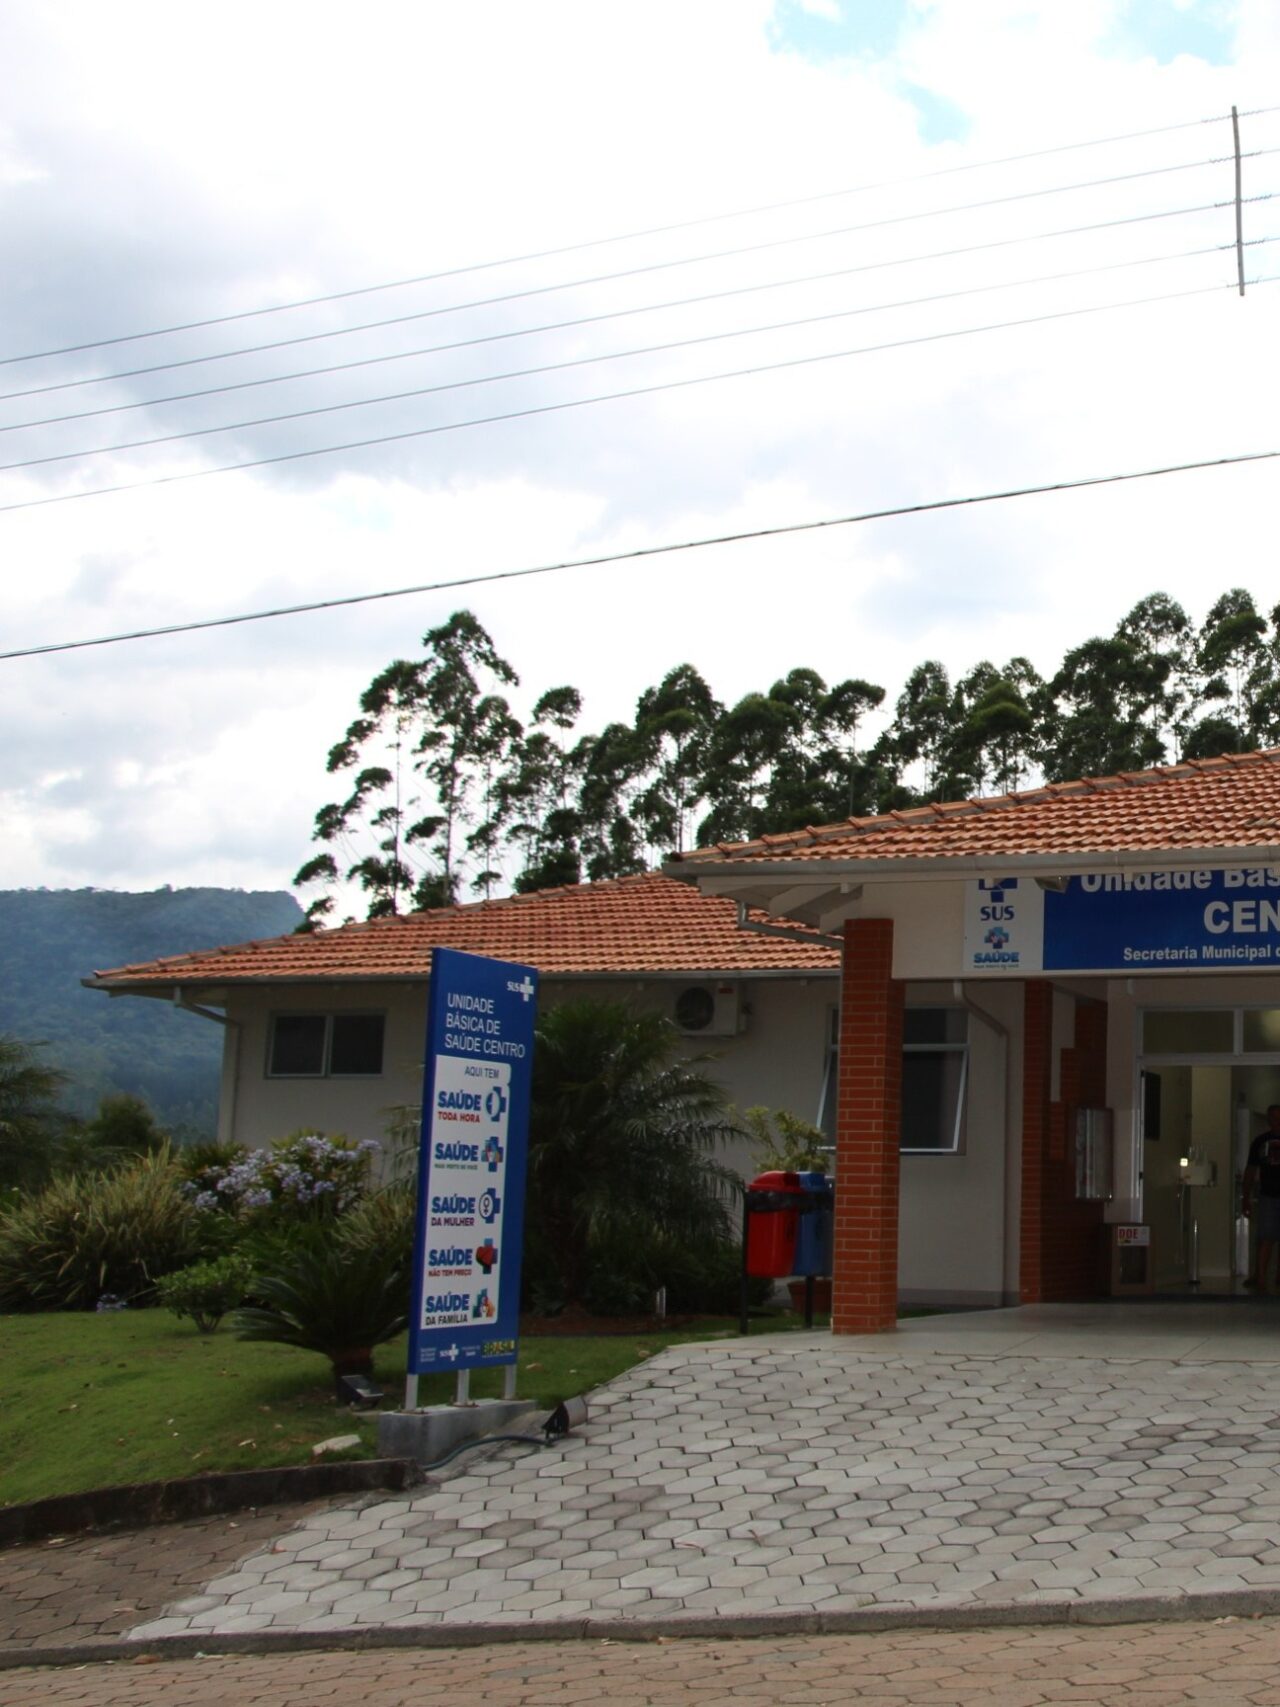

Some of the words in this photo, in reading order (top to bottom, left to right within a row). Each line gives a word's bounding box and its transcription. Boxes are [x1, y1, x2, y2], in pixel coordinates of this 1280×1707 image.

[980, 905, 1015, 921] SUS
[973, 951, 1019, 963] SAÚDE
[1123, 946, 1198, 962] Secretaria
[1202, 944, 1271, 962] Municipal
[447, 993, 494, 1014] UNIDADE
[446, 1012, 485, 1034] BÁSICA
[486, 1019, 501, 1035] DE
[445, 1033, 481, 1053] SAÚDE
[483, 1038, 525, 1059] CENTRO
[464, 1065, 483, 1078] AQUI
[485, 1067, 499, 1079] TEM
[438, 1089, 482, 1111] SAÚDE
[438, 1111, 457, 1122] TODA
[460, 1112, 481, 1123] HORA
[435, 1140, 478, 1162] SAÚDE
[431, 1193, 475, 1214] SAÚDE
[431, 1216, 442, 1227] DA
[444, 1216, 475, 1227] MULHER
[428, 1245, 473, 1266] SAÚDE
[425, 1291, 470, 1313] SAÚDE
[425, 1315, 436, 1326] DA
